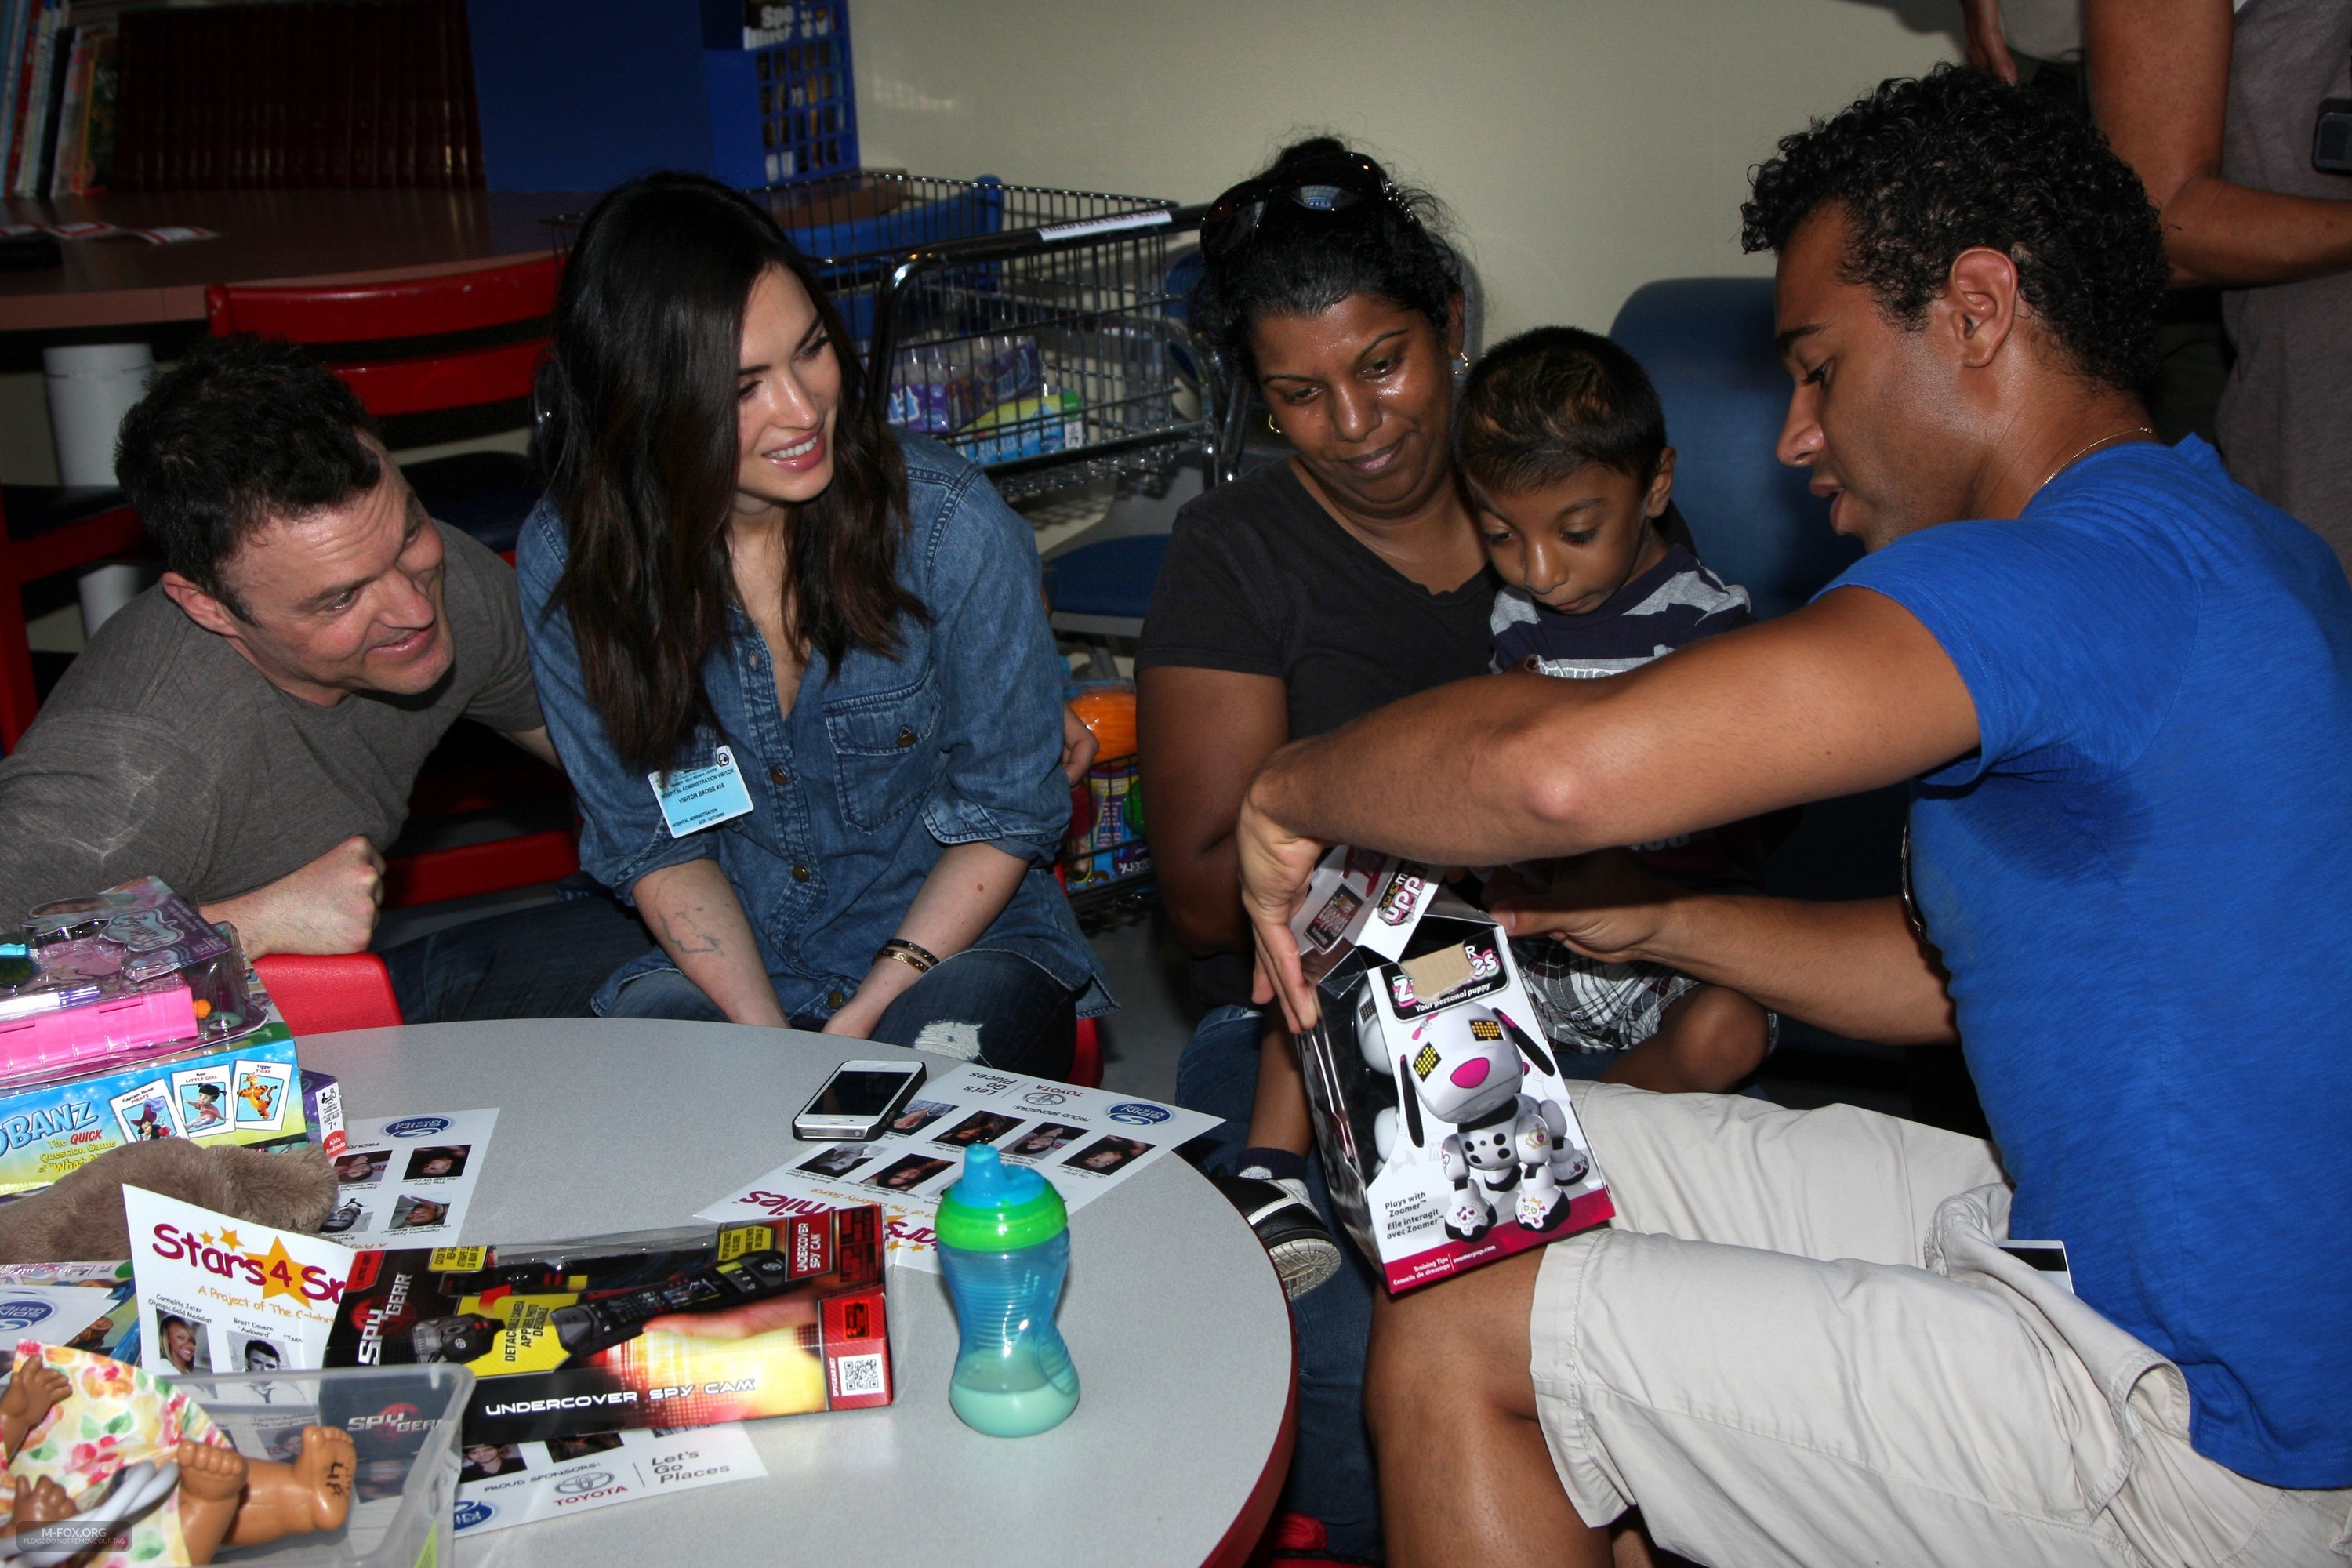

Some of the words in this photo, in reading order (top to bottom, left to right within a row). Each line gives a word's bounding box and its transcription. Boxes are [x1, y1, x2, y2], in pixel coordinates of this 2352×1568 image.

[661, 789, 682, 799] HOSPITAL
[682, 775, 717, 791] ADMINISTRATION
[718, 768, 735, 779] VISITOR
[678, 793, 698, 804] VISITOR
[699, 786, 717, 797] BADGE
[1414, 1001, 1434, 1013] Your
[1434, 989, 1468, 1009] personal
[1468, 982, 1491, 997] puppy
[967, 1072, 1018, 1085] Places
[985, 1083, 1007, 1091] Go
[122, 1092, 141, 1103] Captain
[962, 1084, 999, 1096] Let's
[1034, 1084, 1083, 1098] TOYOTA
[328, 1121, 338, 1131] 7+
[1062, 1112, 1091, 1122] PROUD
[48, 1138, 67, 1150] The
[70, 1129, 103, 1145] QUICK
[326, 1142, 347, 1155] Enfants
[329, 1136, 342, 1147] Kids
[40, 1148, 85, 1164] Question
[87, 1139, 117, 1152] Game
[38, 1163, 48, 1174] of
[811, 1188, 844, 1199] Source
[1385, 1199, 1406, 1210] Plays
[1408, 1191, 1426, 1203] with
[1387, 1220, 1403, 1231] Elle
[1403, 1208, 1439, 1226] interagit
[811, 1233, 822, 1250] CAM
[887, 1221, 938, 1243] ars
[1386, 1229, 1406, 1240] avec
[152, 1223, 267, 1287] Stars
[269, 1259, 293, 1288] 4
[797, 1222, 809, 1272] UNDERCOVER
[1453, 1244, 1497, 1264] zoomerpup.com
[810, 1251, 821, 1269] SPY
[1413, 1260, 1437, 1272] Training
[1436, 1257, 1449, 1265] Tips
[1392, 1274, 1416, 1286] Conseils
[1425, 1263, 1450, 1276] dressage
[156, 1294, 185, 1308] Carmelita
[186, 1303, 203, 1313] Jeter
[198, 1285, 208, 1295] A
[210, 1287, 249, 1308] Project
[254, 1301, 265, 1312] of
[270, 1303, 292, 1318] The
[385, 1272, 413, 1316] GEAR
[148, 1298, 172, 1313] Olympic
[172, 1305, 187, 1316] Gold
[187, 1310, 212, 1324] Medalist
[234, 1317, 250, 1327] Brett
[358, 1308, 389, 1366] SPY
[829, 1357, 840, 1397] SPYGEAR.NET
[485, 1391, 638, 1417] UNDERCOVER
[648, 1384, 695, 1401] SPY
[703, 1379, 753, 1396] CAM
[347, 1412, 405, 1432] SPY
[651, 1450, 699, 1467] Let's
[484, 1479, 525, 1493] PROUD
[530, 1461, 602, 1483] SPONSORS:
[653, 1463, 683, 1475] Go
[659, 1464, 731, 1485] Places
[554, 1484, 629, 1507] TOYOTA
